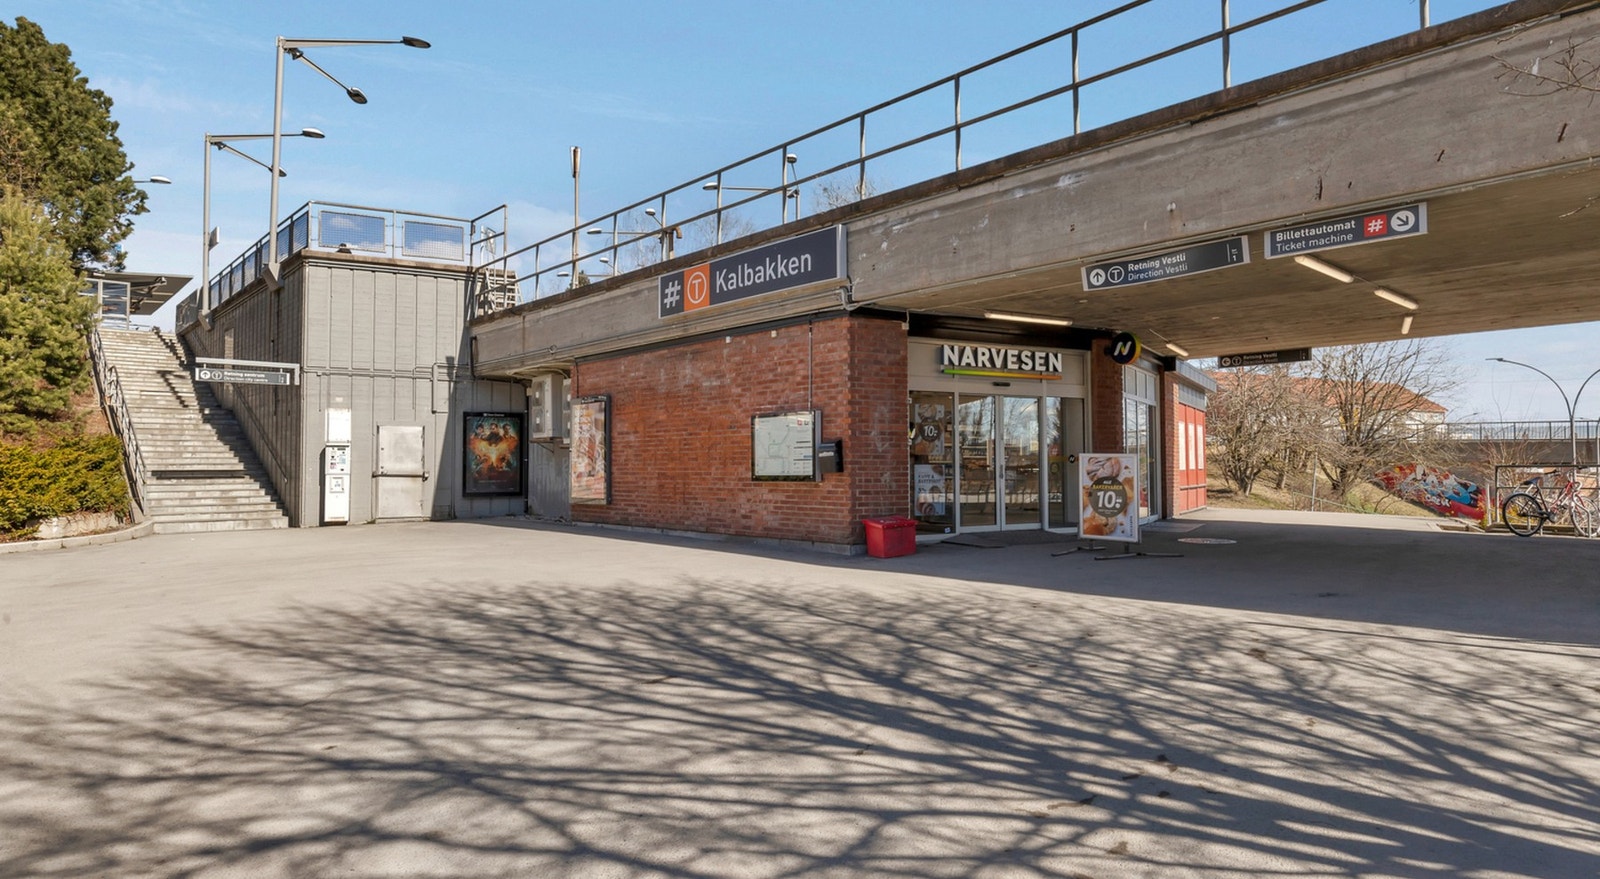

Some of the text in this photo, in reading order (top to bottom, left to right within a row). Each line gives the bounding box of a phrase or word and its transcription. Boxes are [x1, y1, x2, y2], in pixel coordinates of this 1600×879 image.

[1276, 220, 1356, 242] Billettautomat
[1276, 233, 1353, 252] Ticket machine
[1128, 260, 1160, 271] Retning
[1161, 253, 1186, 265] Vestli
[1128, 263, 1188, 281] Direction Vestli
[716, 253, 812, 294] Kalbakken
[943, 344, 1063, 372] NARVESEN
